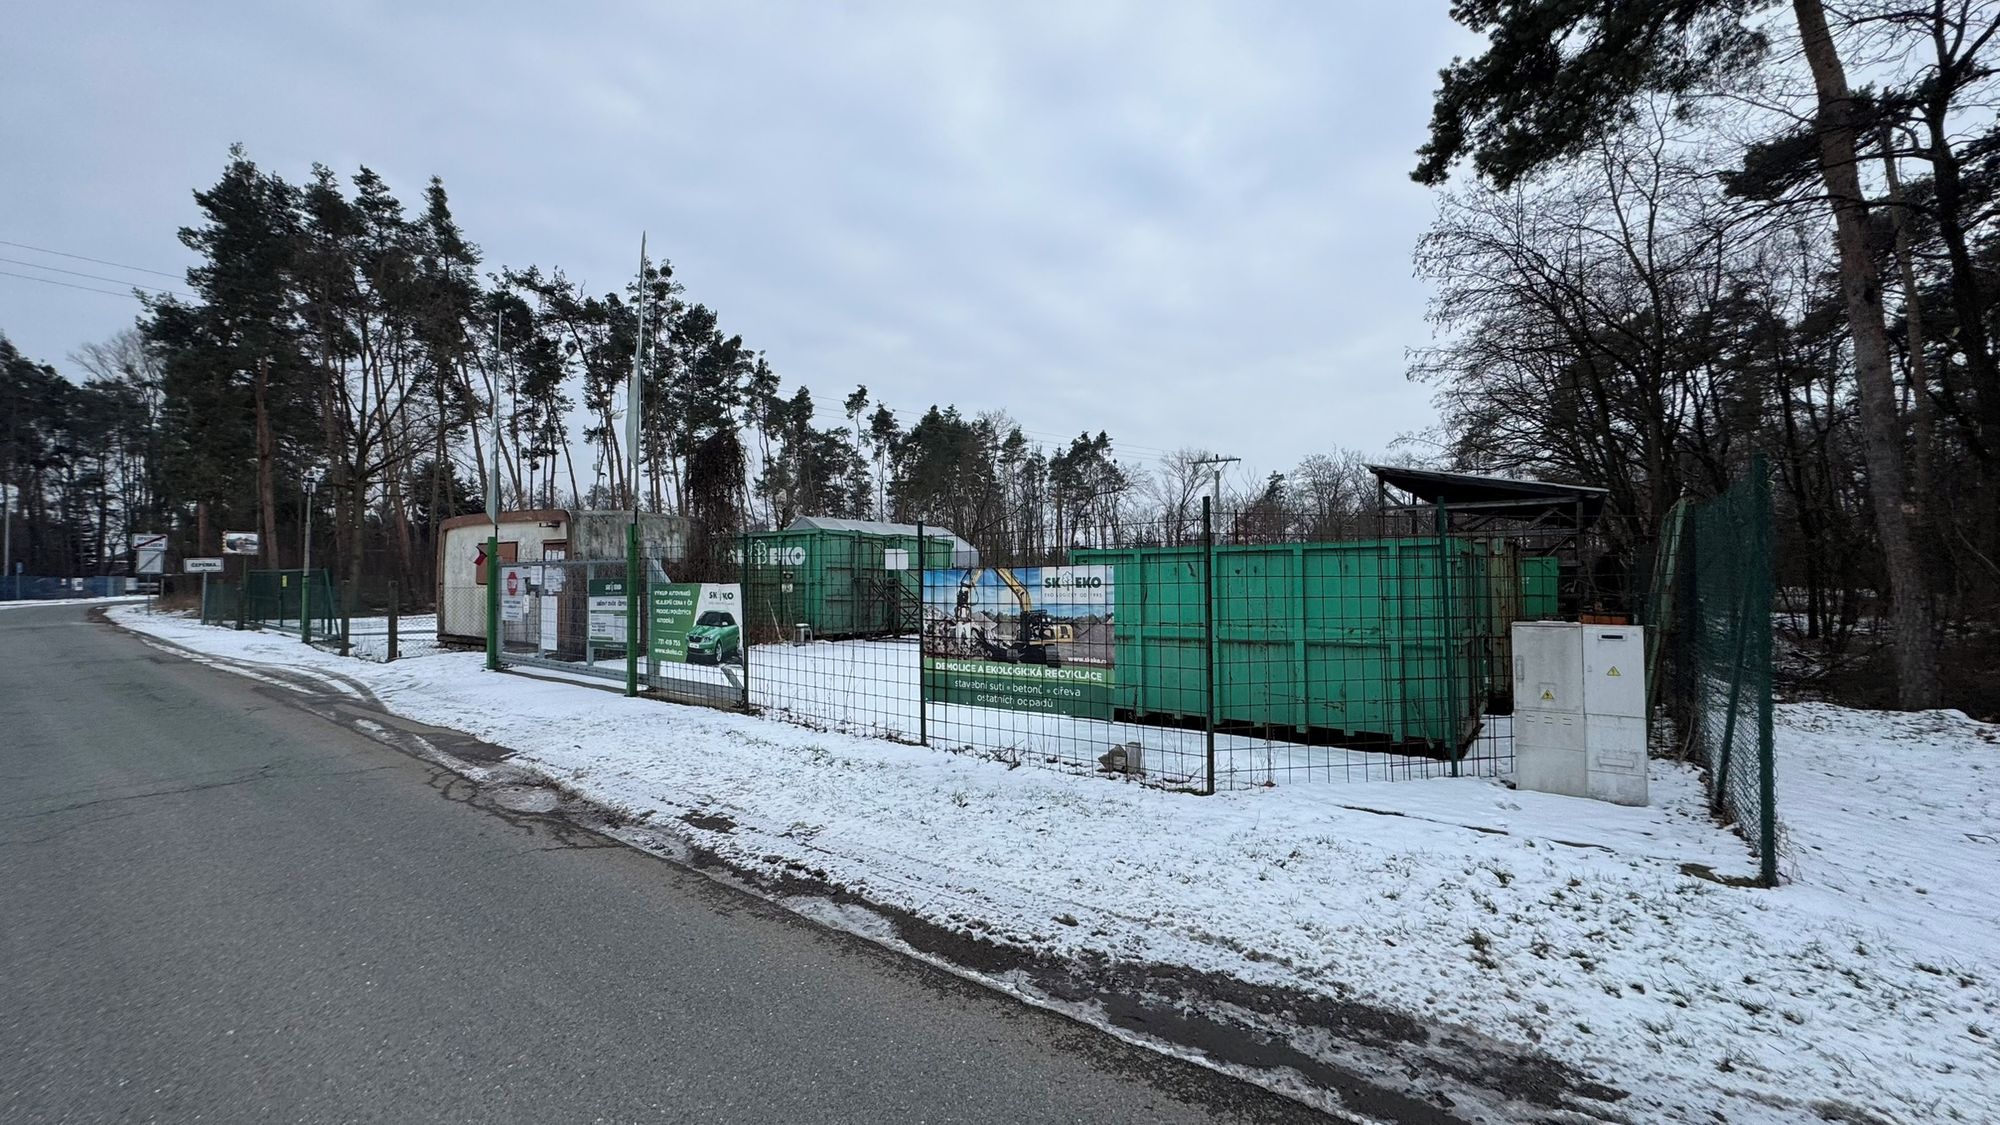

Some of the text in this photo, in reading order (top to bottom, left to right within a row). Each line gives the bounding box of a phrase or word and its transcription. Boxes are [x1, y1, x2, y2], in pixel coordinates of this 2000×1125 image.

[935, 661, 976, 673] DEMOLICE
[985, 666, 1043, 678] EKOLOGICKÁ
[1045, 668, 1103, 682] RECYKLACE
[954, 679, 988, 689] stavební
[989, 682, 1005, 691] suti
[976, 693, 1015, 705] ostatních
